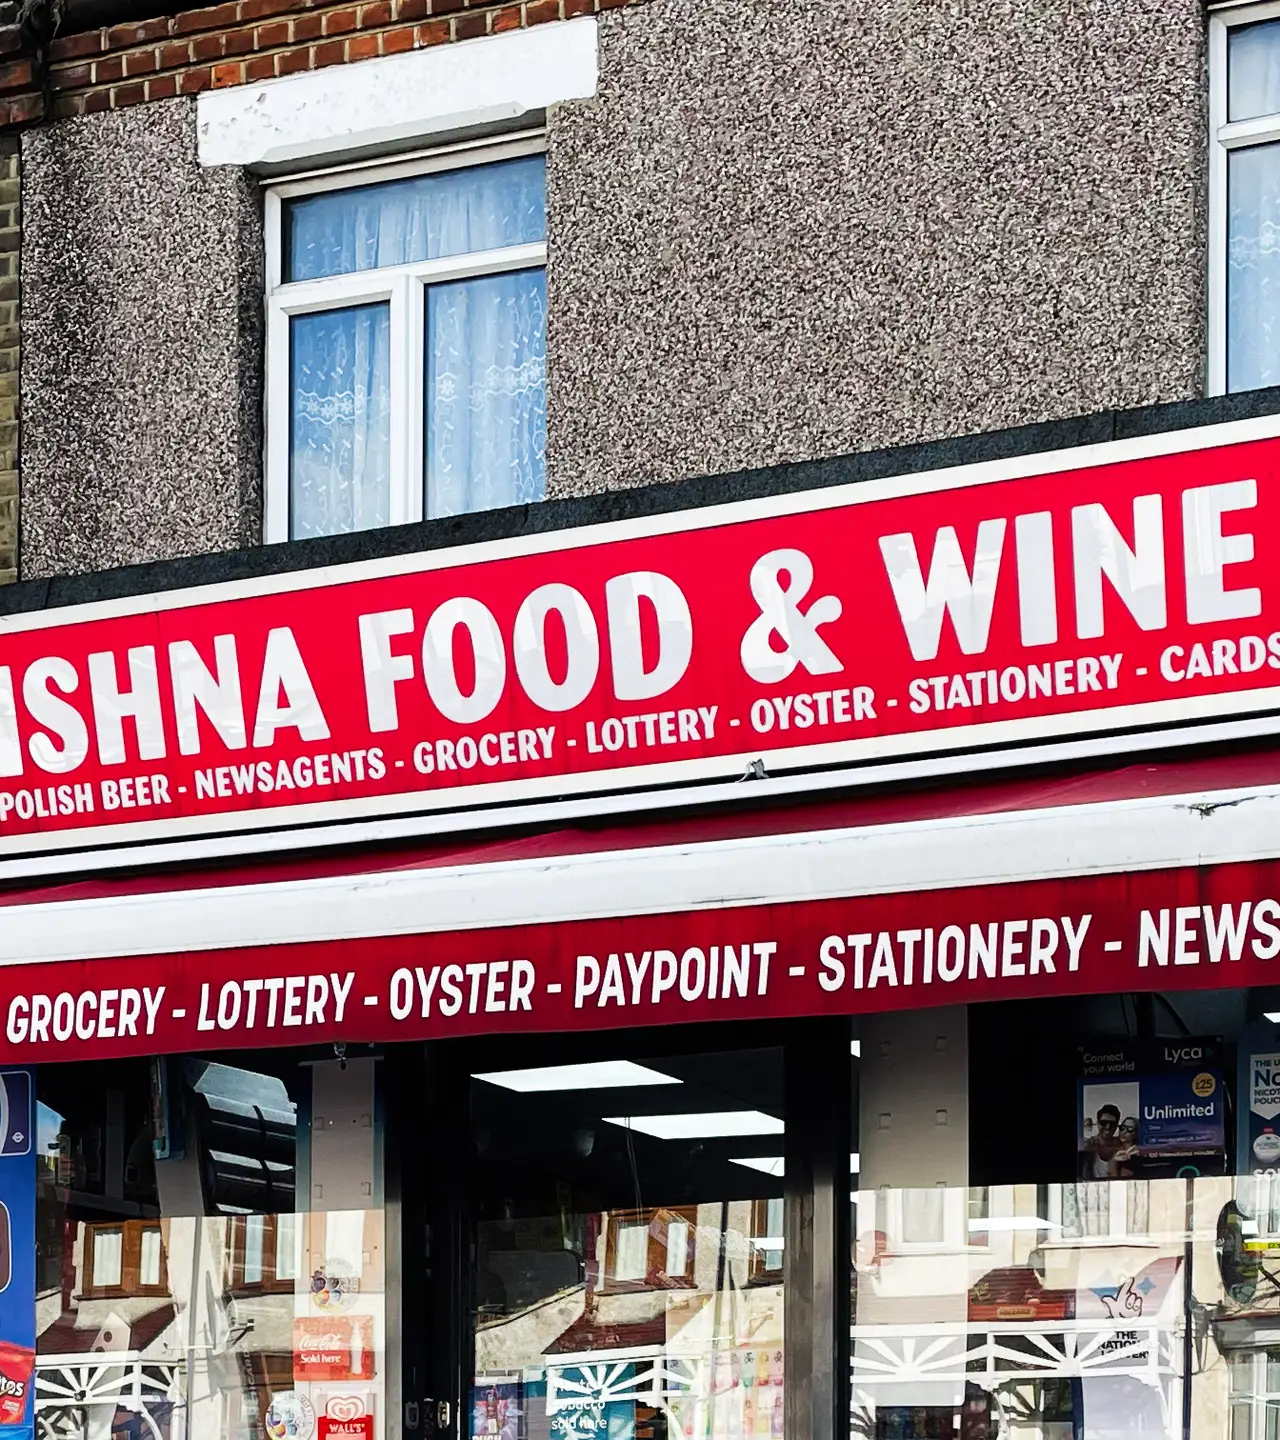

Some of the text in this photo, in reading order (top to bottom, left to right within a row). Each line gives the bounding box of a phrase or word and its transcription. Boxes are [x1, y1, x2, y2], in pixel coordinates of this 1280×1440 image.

[358, 570, 693, 734] FOOD
[739, 547, 844, 684] &
[878, 479, 1263, 662] WINE
[102, 773, 171, 811] BEER
[194, 747, 386, 801] NEWSAGENTS
[413, 726, 556, 775] GROCERY
[586, 705, 719, 755] LOTTERY
[750, 686, 877, 734] OYSTER
[908, 652, 1124, 715] STATIONERY
[6, 986, 166, 1044] GROCERY
[196, 971, 356, 1032] LOTTERY
[389, 959, 535, 1020] OYSTER
[574, 941, 777, 1009] PAYPOINT
[818, 913, 1093, 992] STATIONERY
[1083, 1052, 1124, 1063] Connect
[1164, 1047, 1202, 1064] Lyca
[1108, 1062, 1135, 1073] world
[1144, 1102, 1214, 1120] Unlimited
[300, 1353, 341, 1364] Sold here
